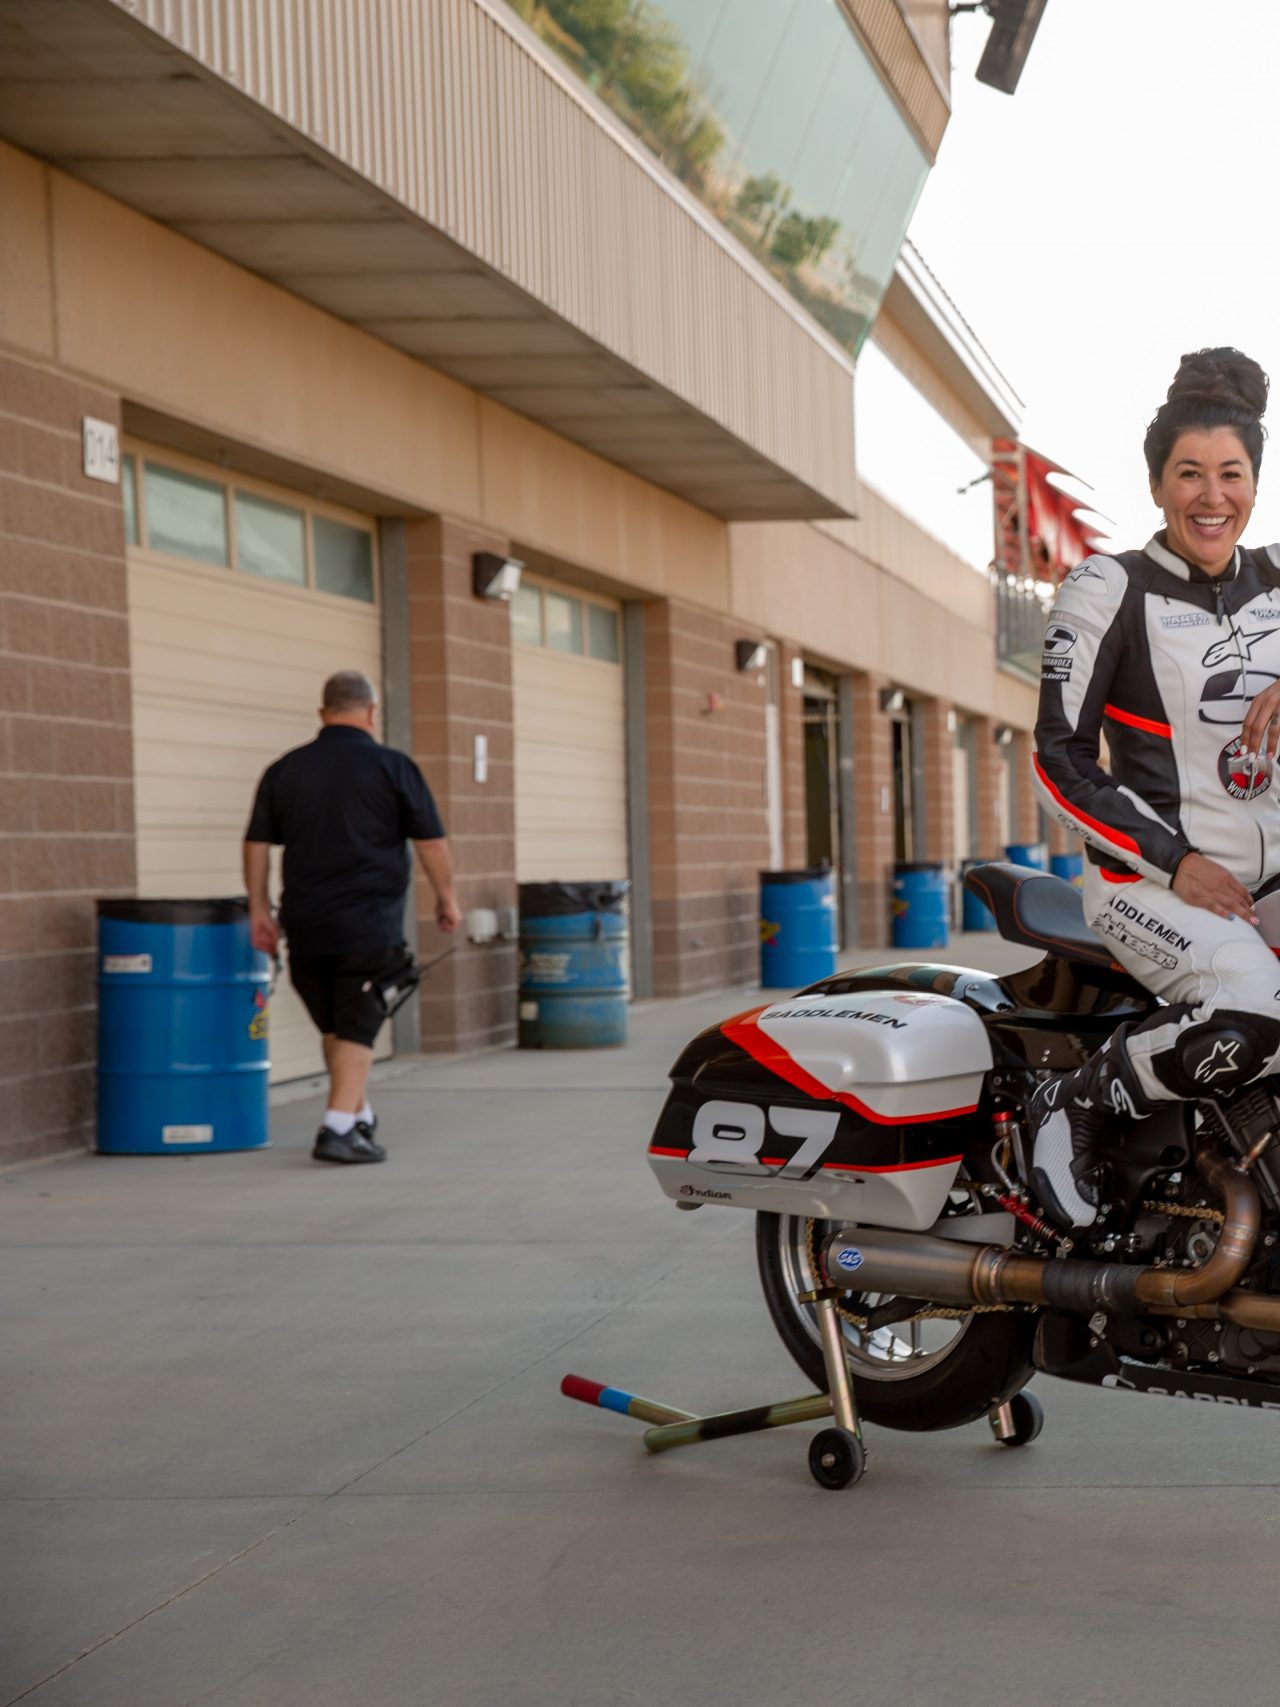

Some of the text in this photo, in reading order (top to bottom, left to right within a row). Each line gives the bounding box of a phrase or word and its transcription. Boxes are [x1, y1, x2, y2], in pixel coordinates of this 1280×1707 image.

[760, 1008, 908, 1030] SADDLEMEN
[683, 1099, 842, 1182] 87
[679, 1184, 733, 1201] Indian
